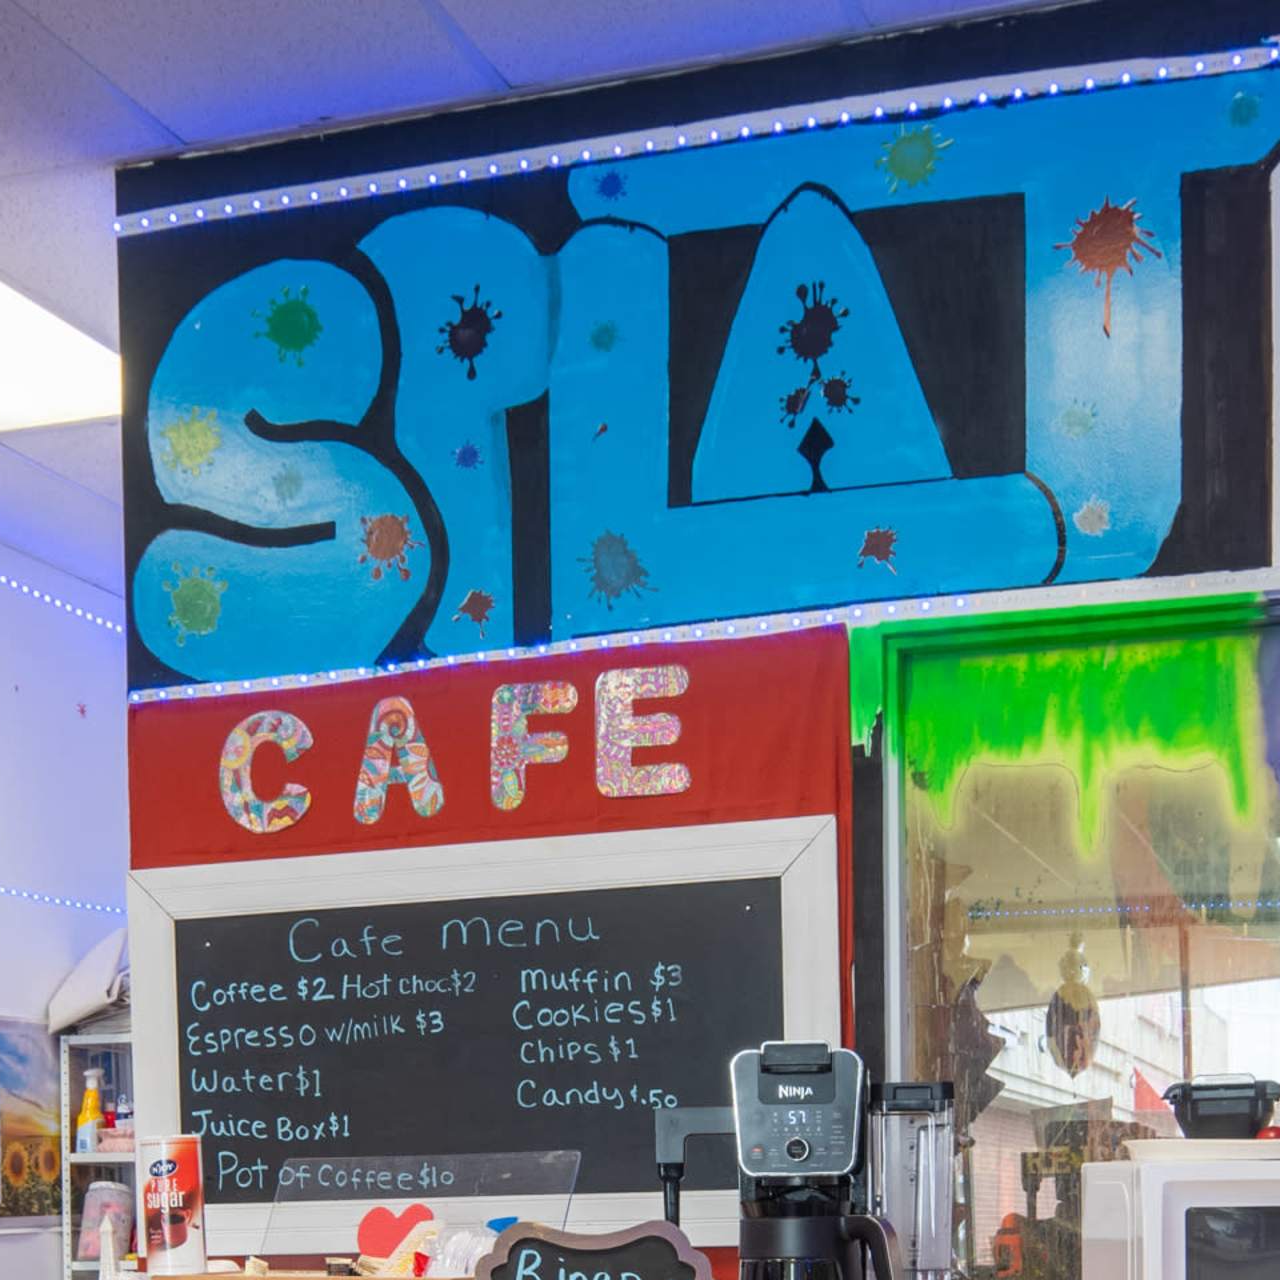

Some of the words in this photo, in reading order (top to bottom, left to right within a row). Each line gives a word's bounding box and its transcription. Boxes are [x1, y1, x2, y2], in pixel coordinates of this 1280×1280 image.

[220, 664, 692, 834] CAFE
[288, 917, 404, 963] Cafe
[650, 960, 683, 992] $3
[190, 979, 288, 1012] Coffee
[296, 975, 335, 1002] $2
[341, 973, 392, 1000] Hot
[325, 1013, 406, 1045] w/milk
[415, 1008, 445, 1035] $3
[608, 1035, 639, 1062] $1
[517, 1078, 624, 1110] Candy
[778, 1083, 813, 1100] NINJA
[191, 1108, 268, 1139] Juice
[217, 1150, 269, 1193] Pot
[146, 1191, 186, 1215] sugar
